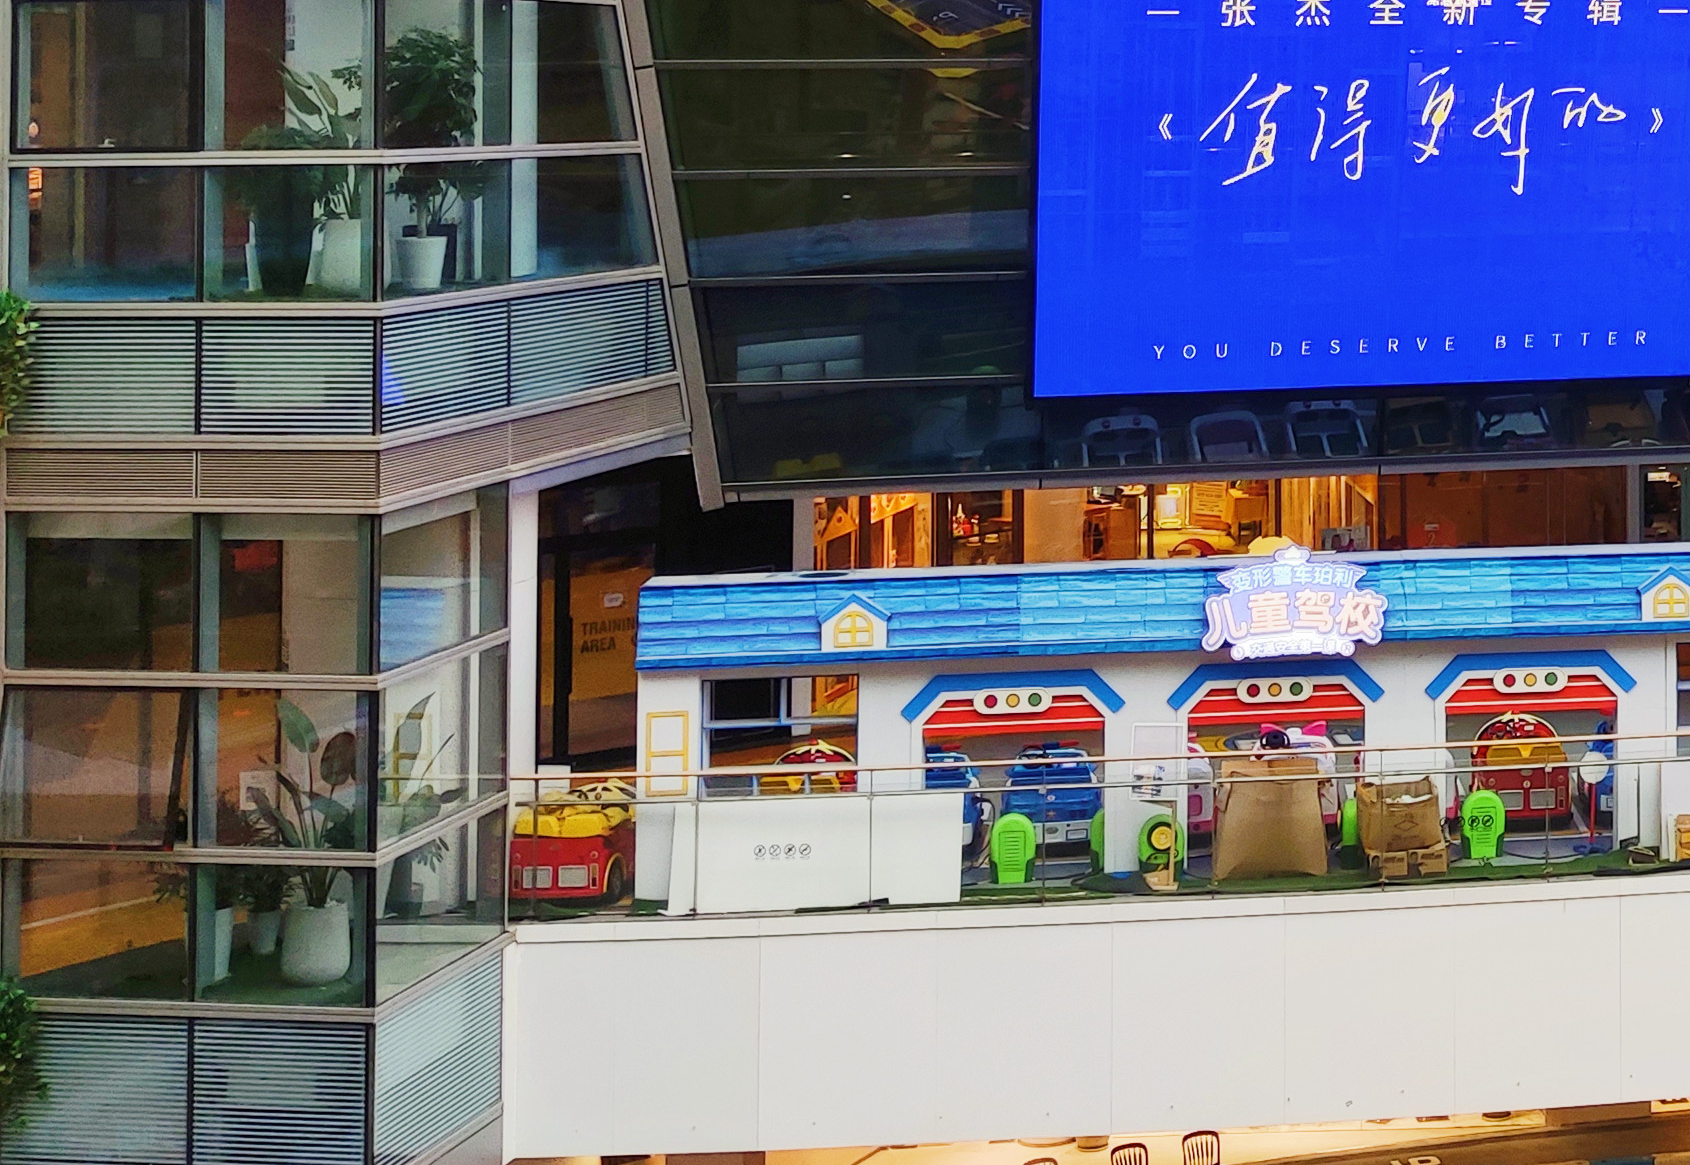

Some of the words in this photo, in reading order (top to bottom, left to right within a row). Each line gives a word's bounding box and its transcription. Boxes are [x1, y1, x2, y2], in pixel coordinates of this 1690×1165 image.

[1153, 343, 1228, 360] YOU
[1270, 336, 1455, 357] DESERVE
[1495, 330, 1648, 350] BETTER
[1231, 564, 1356, 591] 变形警车珀利
[581, 618, 636, 635] TRAININ
[1207, 589, 1384, 645] 儿童驾校
[581, 637, 616, 653] AREA
